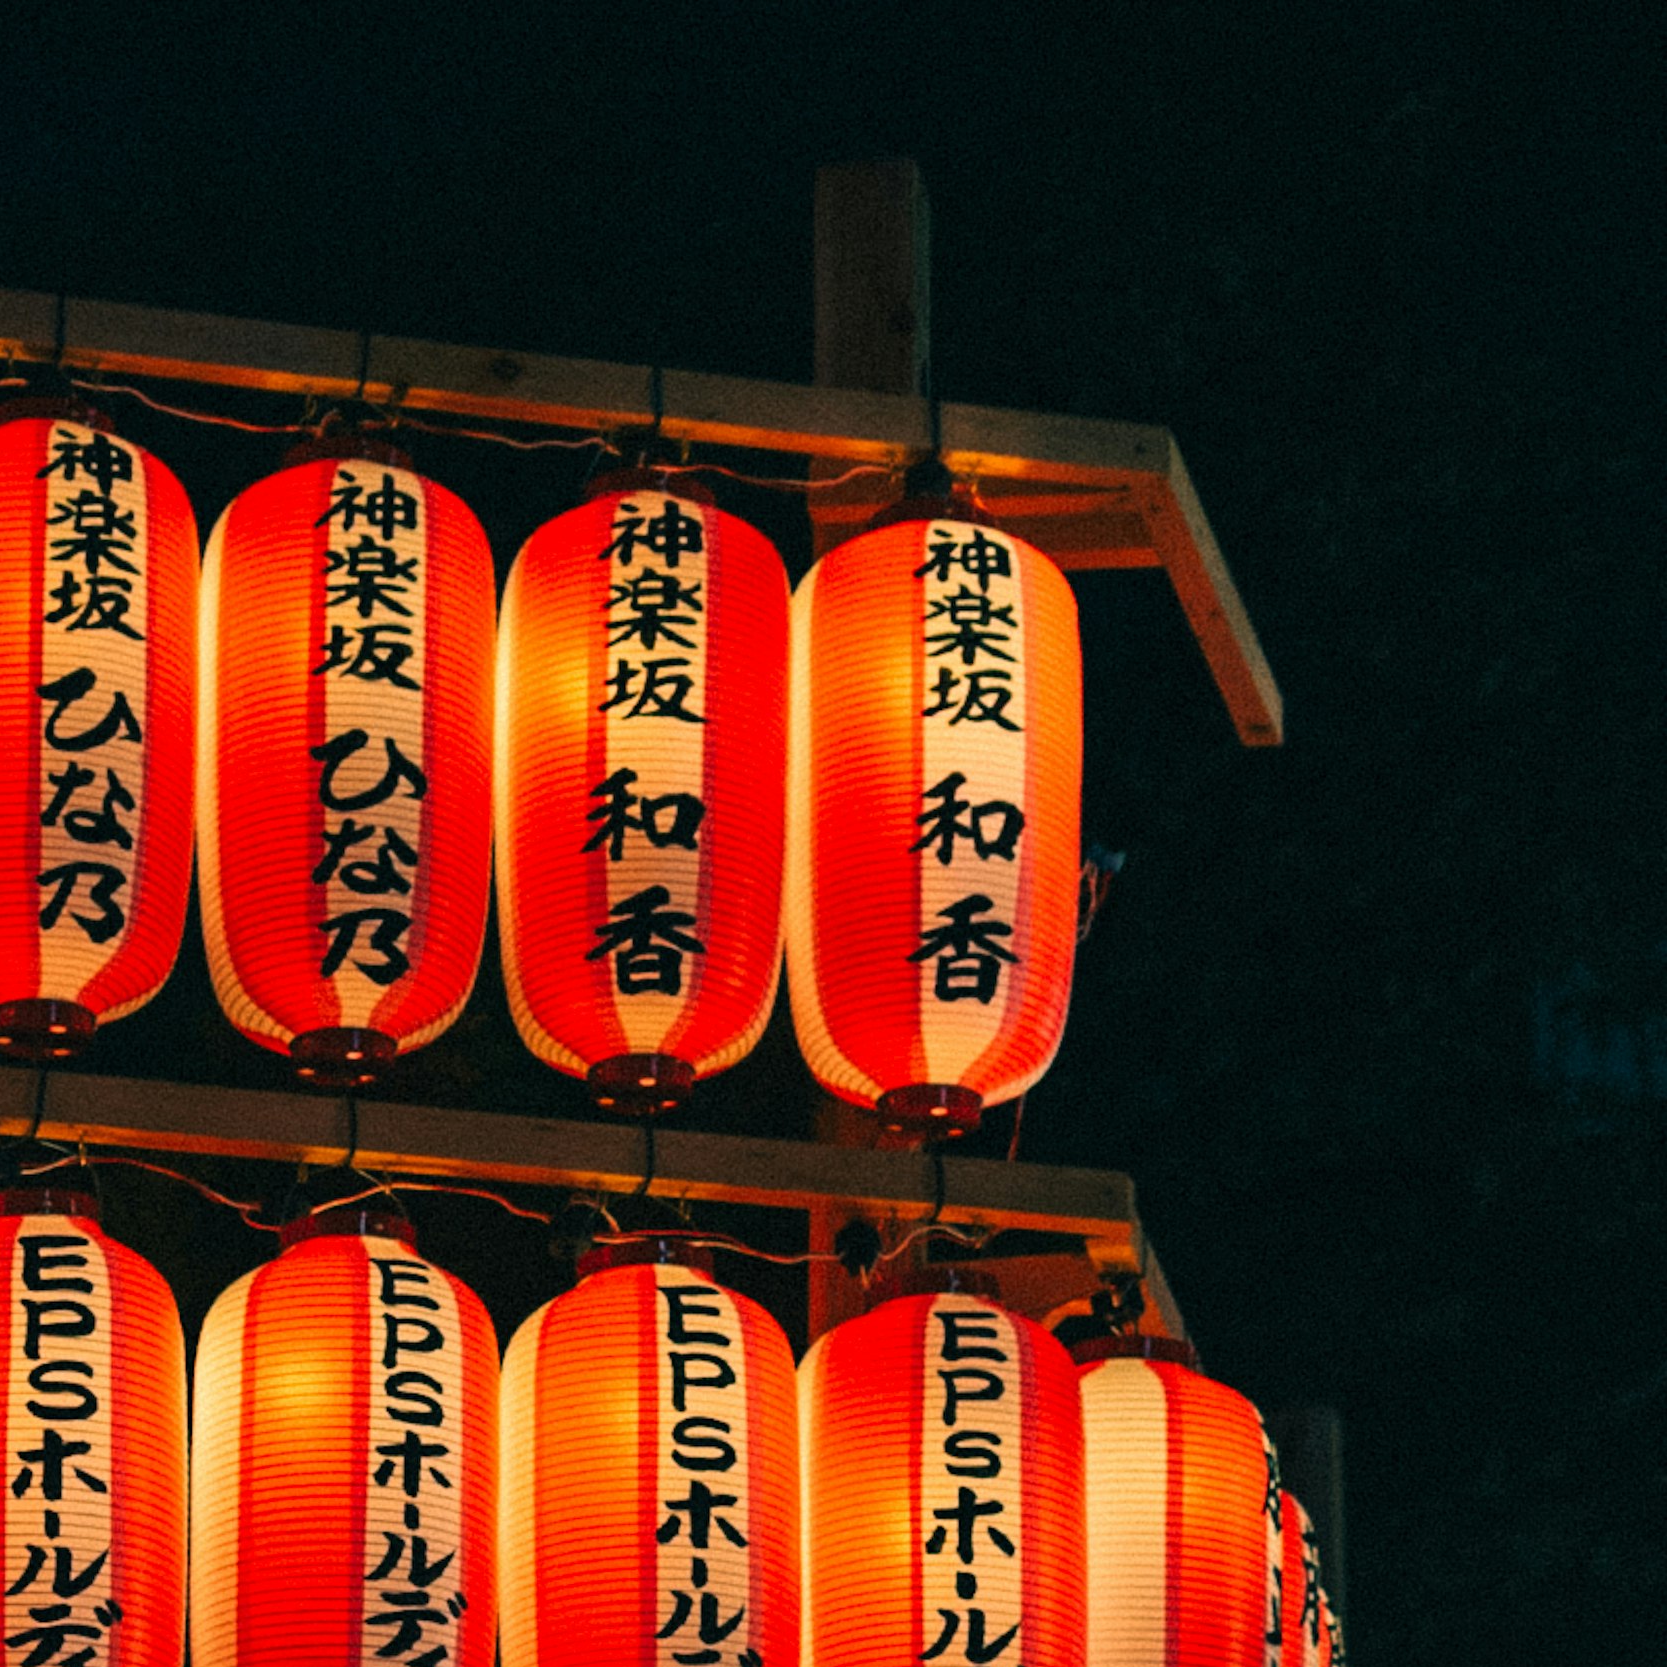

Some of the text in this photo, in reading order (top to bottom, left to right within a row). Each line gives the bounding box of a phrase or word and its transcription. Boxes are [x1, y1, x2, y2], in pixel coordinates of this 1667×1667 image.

[36, 430, 145, 942] 神楽坂 ひな乃
[309, 470, 426, 984] 神楽坂 ひな乃
[580, 501, 707, 997] 神楽坂 和香
[906, 530, 1025, 1005] 神楽坂 和香
